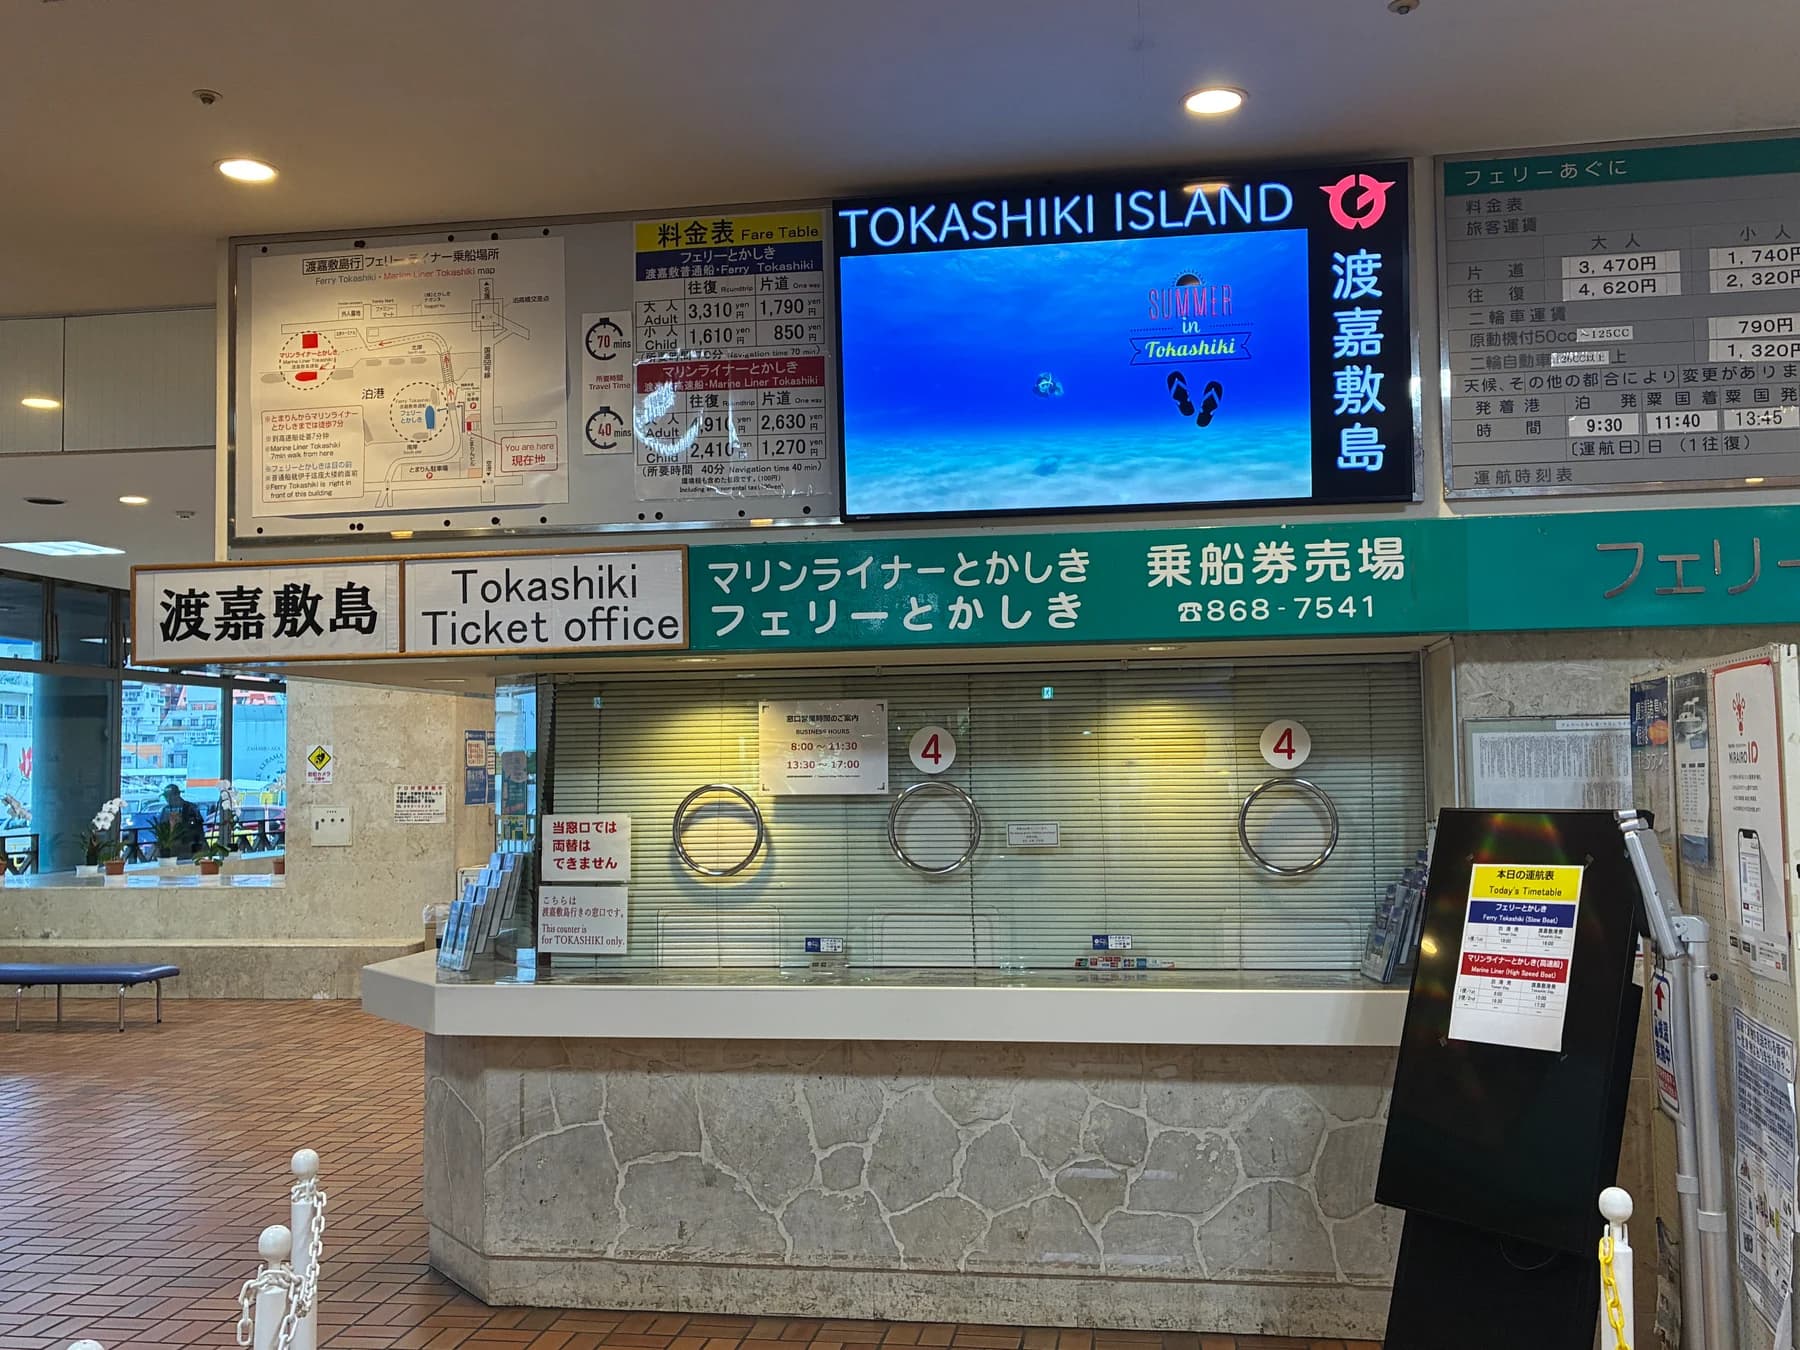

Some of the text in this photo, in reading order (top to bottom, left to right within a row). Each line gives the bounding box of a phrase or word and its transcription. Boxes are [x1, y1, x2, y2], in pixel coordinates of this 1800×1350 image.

[1465, 160, 1628, 187] フェリーあぐに
[1465, 198, 1524, 214] 料金表
[838, 182, 1295, 249] TOKASHIKI ISLAND
[658, 219, 819, 248] 料金表 Fare Table
[1466, 216, 1537, 236] 旅客運賃
[1591, 224, 1791, 250] 大人 小人
[680, 246, 777, 264] フェリーとかしき
[757, 260, 814, 272] Tokashiki
[1467, 262, 1525, 281] 片道
[315, 276, 336, 286] Ferry
[436, 268, 476, 277] Tokashiki
[477, 267, 496, 276] map
[688, 276, 789, 295] 往復 片道
[1468, 285, 1525, 303] 往復
[644, 301, 678, 313] 大人
[688, 303, 733, 320] 3,310
[736, 302, 750, 310] yen
[760, 300, 804, 316] 1,790
[1149, 284, 1232, 320] SUMMER
[644, 313, 678, 325] Adult
[736, 307, 816, 319] 円 円
[1469, 306, 1567, 325] 二輪車運賃
[1182, 316, 1200, 334] in
[1738, 317, 1793, 334] 790円
[597, 335, 631, 349] 70 mins
[644, 325, 678, 337] 小人
[690, 328, 733, 345] 1,610
[774, 325, 804, 340] 850
[736, 333, 817, 345] 円 円
[645, 339, 678, 350] Child
[1145, 338, 1237, 359] Tokashiki
[1330, 247, 1387, 473] 渡嘉敷島
[662, 361, 799, 378] マリンライナーとかしき
[589, 382, 611, 390] Travel
[744, 376, 818, 388] Liner Tokashiki
[362, 388, 385, 400] 泊港
[689, 391, 791, 409] 往復 片道
[1475, 398, 1540, 415] 発着港
[598, 423, 632, 437] 40 mins
[737, 416, 751, 424] yen
[761, 414, 806, 431] 2,630
[1586, 418, 1623, 433] 9:30
[1655, 413, 1701, 430] 11:40
[1735, 410, 1783, 427] 13:45
[646, 427, 679, 438] Adult
[311, 442, 340, 450] Tokashiki
[505, 443, 517, 451] You
[536, 442, 554, 450] here
[690, 441, 735, 458] 2,410
[762, 439, 806, 456] 1,270
[287, 451, 303, 459] walk
[512, 454, 546, 466] 現在地
[289, 480, 344, 489] Tokashiki right
[1474, 468, 1574, 486] 運航時刻表
[308, 489, 333, 498] building
[1146, 536, 1408, 588] 乗船券売場
[707, 547, 1091, 595] マリンライナーとかしき
[451, 564, 638, 604] Tokashiki
[159, 580, 379, 644] 渡嘉敷島
[710, 591, 1085, 638] フェリーとかしき
[421, 606, 680, 647] Ticket office
[791, 742, 858, 751] 8:00 11:30
[920, 733, 942, 765] 4
[1273, 727, 1296, 760] 4
[787, 760, 860, 769] 13:30 17:00
[552, 821, 618, 835] 当窓口では
[552, 839, 591, 853] 両替は
[553, 856, 618, 870] できません
[1496, 870, 1555, 881] 本日の運航表
[1489, 886, 1562, 897] Today's Timetable
[543, 895, 577, 906] こちらは
[1496, 903, 1547, 913] フェリーとかしき
[541, 907, 624, 919] 渡嘉敷島行きの窓口です。
[1482, 914, 1498, 922] Ferry
[542, 923, 587, 934] This counter is
[541, 935, 625, 948] for TOKASHIKI only.
[1490, 966, 1504, 975] Liner
[1521, 968, 1539, 978] Speed
